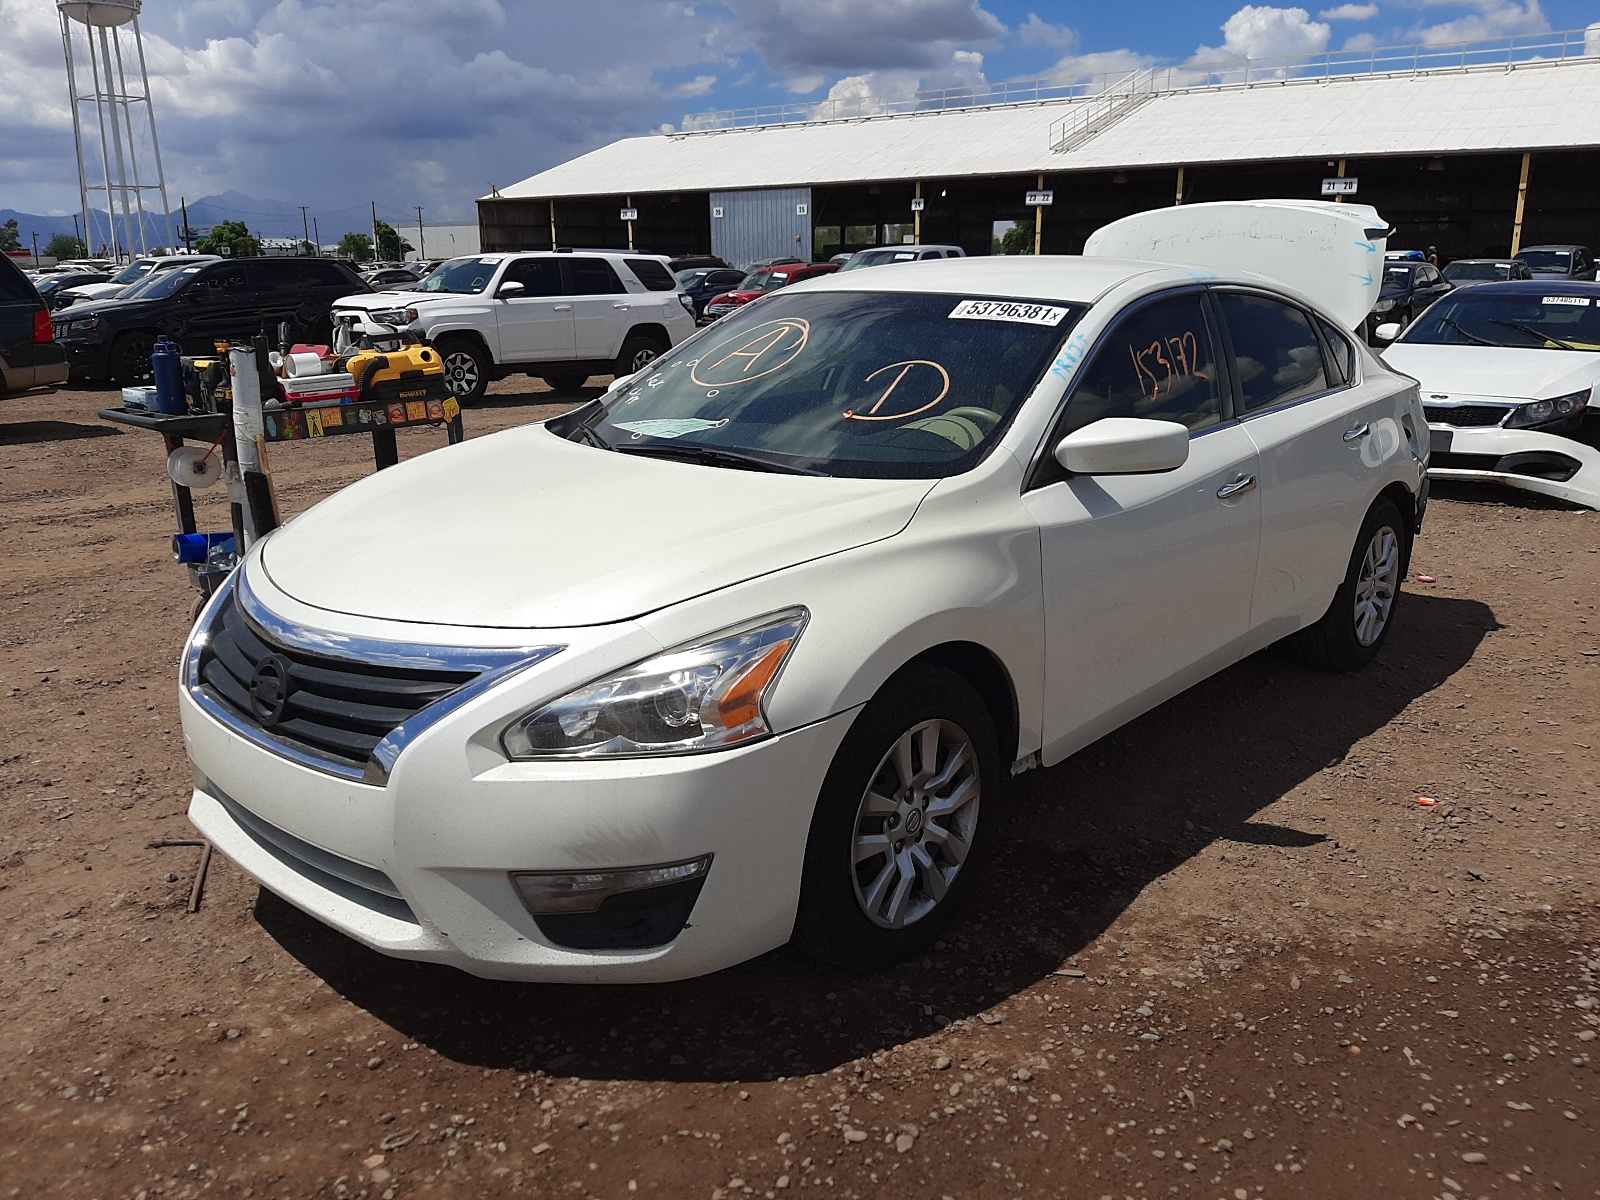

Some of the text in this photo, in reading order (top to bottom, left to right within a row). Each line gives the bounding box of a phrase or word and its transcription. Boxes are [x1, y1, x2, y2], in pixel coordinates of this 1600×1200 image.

[1326, 182, 1353, 190] 21 20
[707, 326, 790, 372] A
[1128, 331, 1210, 401] 153172
[843, 359, 950, 420] D
